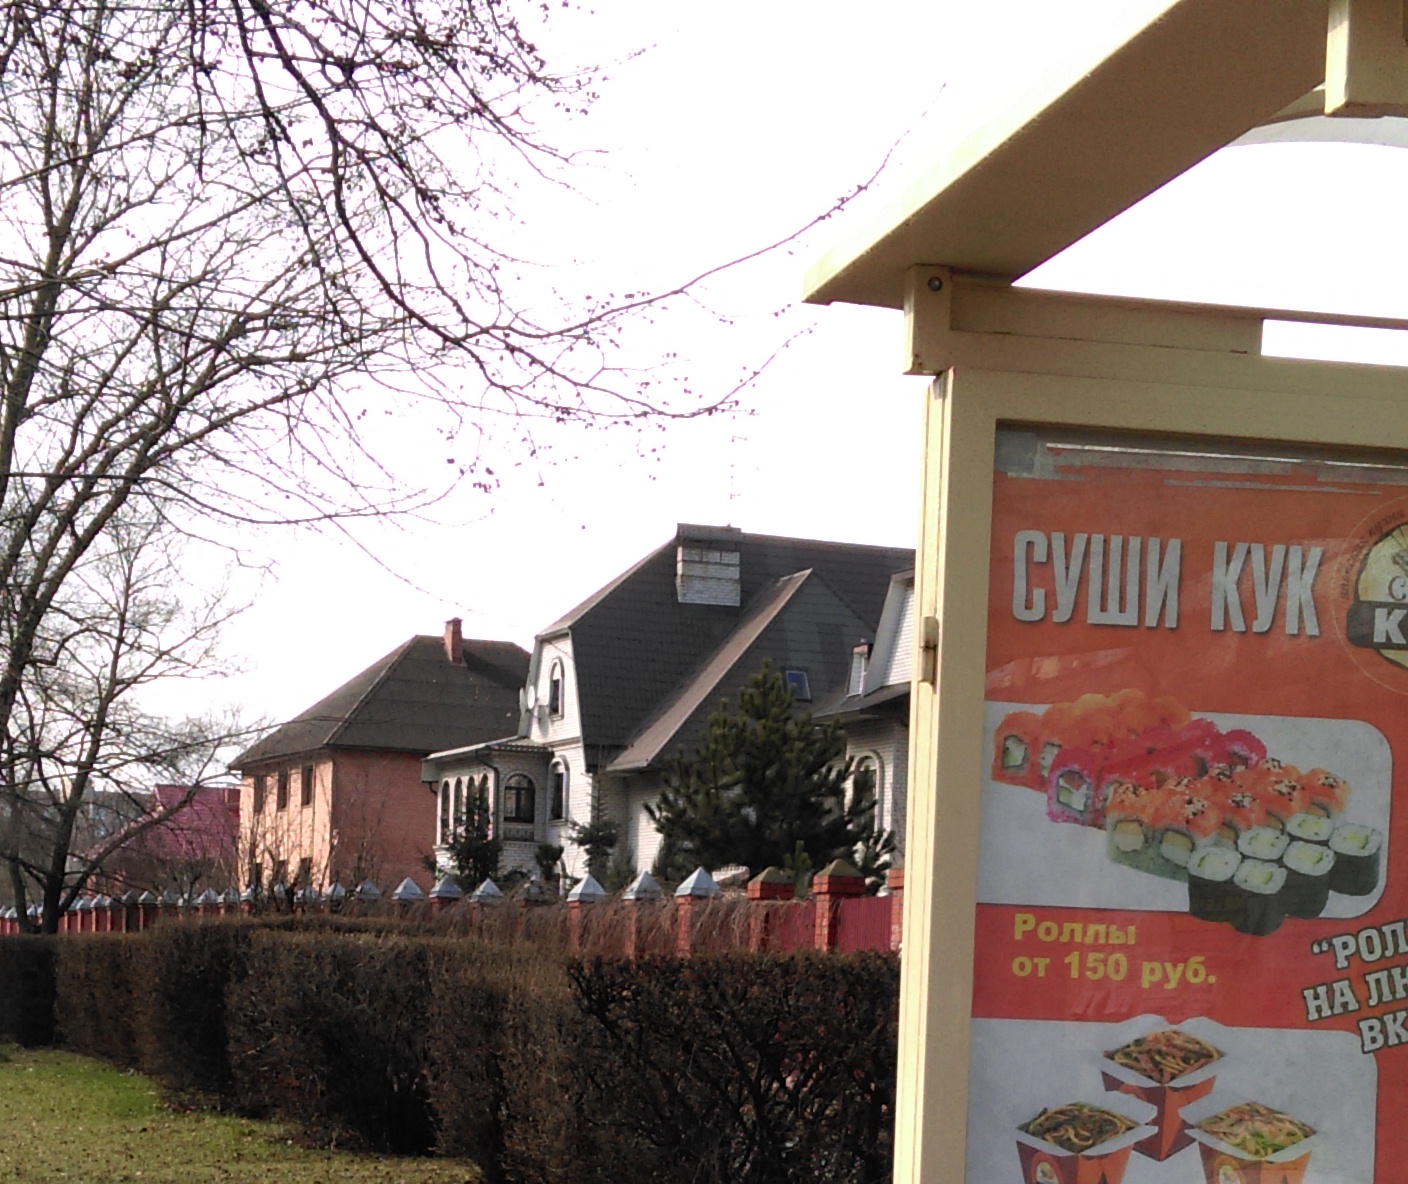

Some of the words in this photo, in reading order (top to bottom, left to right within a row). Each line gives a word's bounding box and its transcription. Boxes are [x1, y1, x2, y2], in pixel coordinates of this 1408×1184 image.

[1012, 530, 1181, 628] СУШИ
[1211, 541, 1323, 636] КУК
[1014, 913, 1137, 946] Роллы
[1012, 957, 1049, 979] от
[1064, 953, 1128, 982] 150
[1141, 958, 1217, 989] руб.
[1302, 981, 1360, 1022] НА
